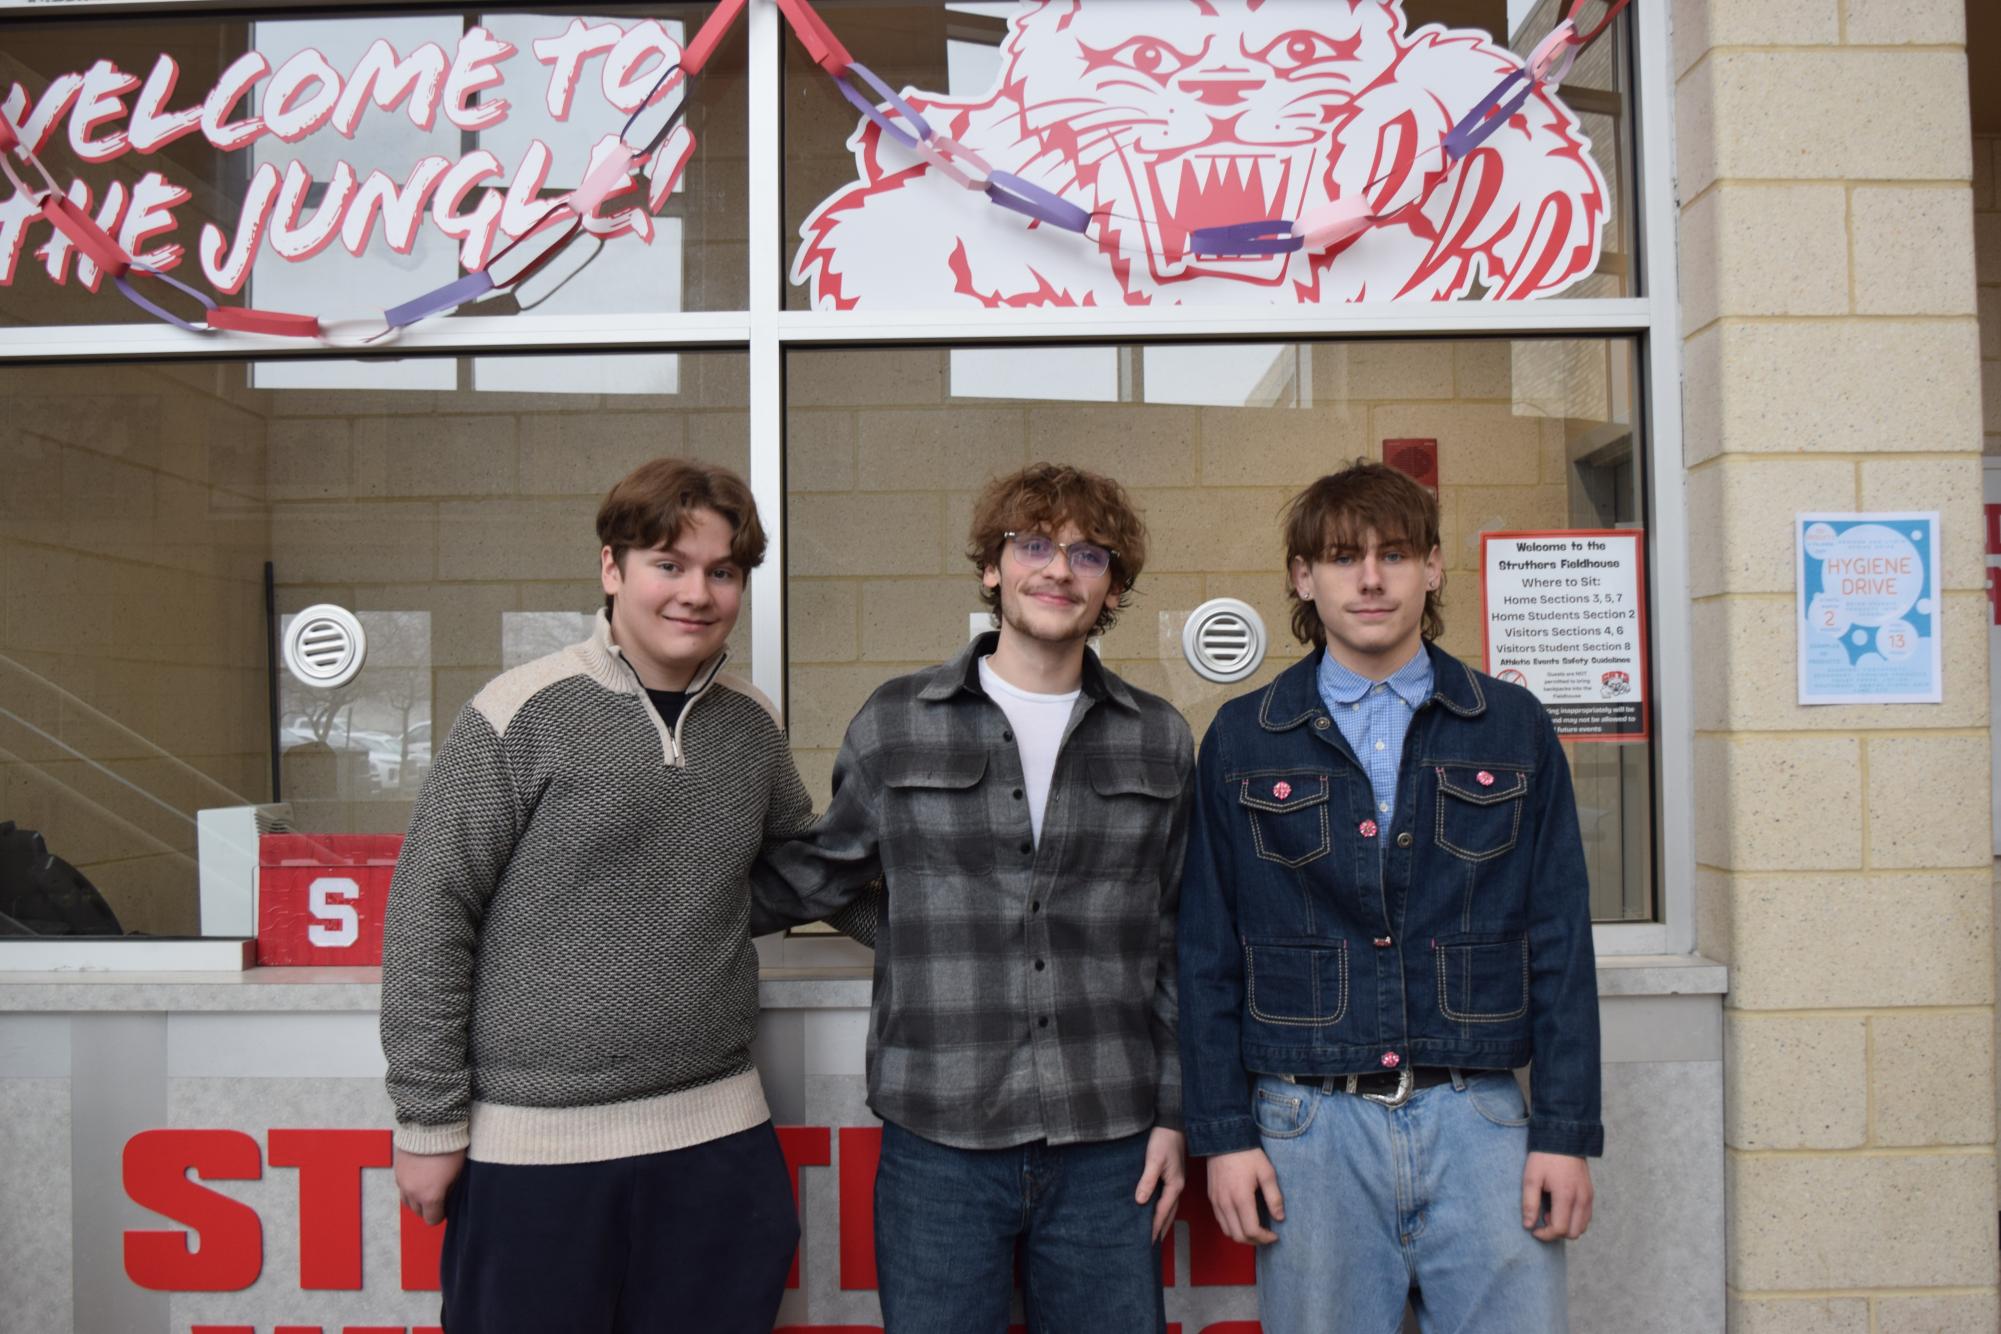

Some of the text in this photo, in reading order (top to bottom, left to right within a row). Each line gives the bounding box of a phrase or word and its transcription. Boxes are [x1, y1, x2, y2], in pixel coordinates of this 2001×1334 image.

[532, 17, 683, 121] TO
[0, 125, 696, 294] THE JUNGLE!
[1516, 540, 1606, 552] Welcome to the
[1498, 559, 1620, 571] Struthers Fieldhouse
[1827, 556, 1912, 575] HYGIENE
[1521, 576, 1601, 588] Where to Sit:
[1841, 577, 1898, 596] DRIVE
[1503, 593, 1623, 605] Home Sections 3, 5, 7
[1491, 609, 1636, 622] Home Students Section 2
[1823, 610, 1835, 627] 2
[1504, 625, 1624, 638] Visitors Sections 4, 6
[1496, 641, 1631, 654] Visitors Student Section 8
[1888, 634, 1905, 649] 13
[1500, 656, 1631, 666] Athletic Events Safety Guidelines
[308, 877, 360, 947] S
